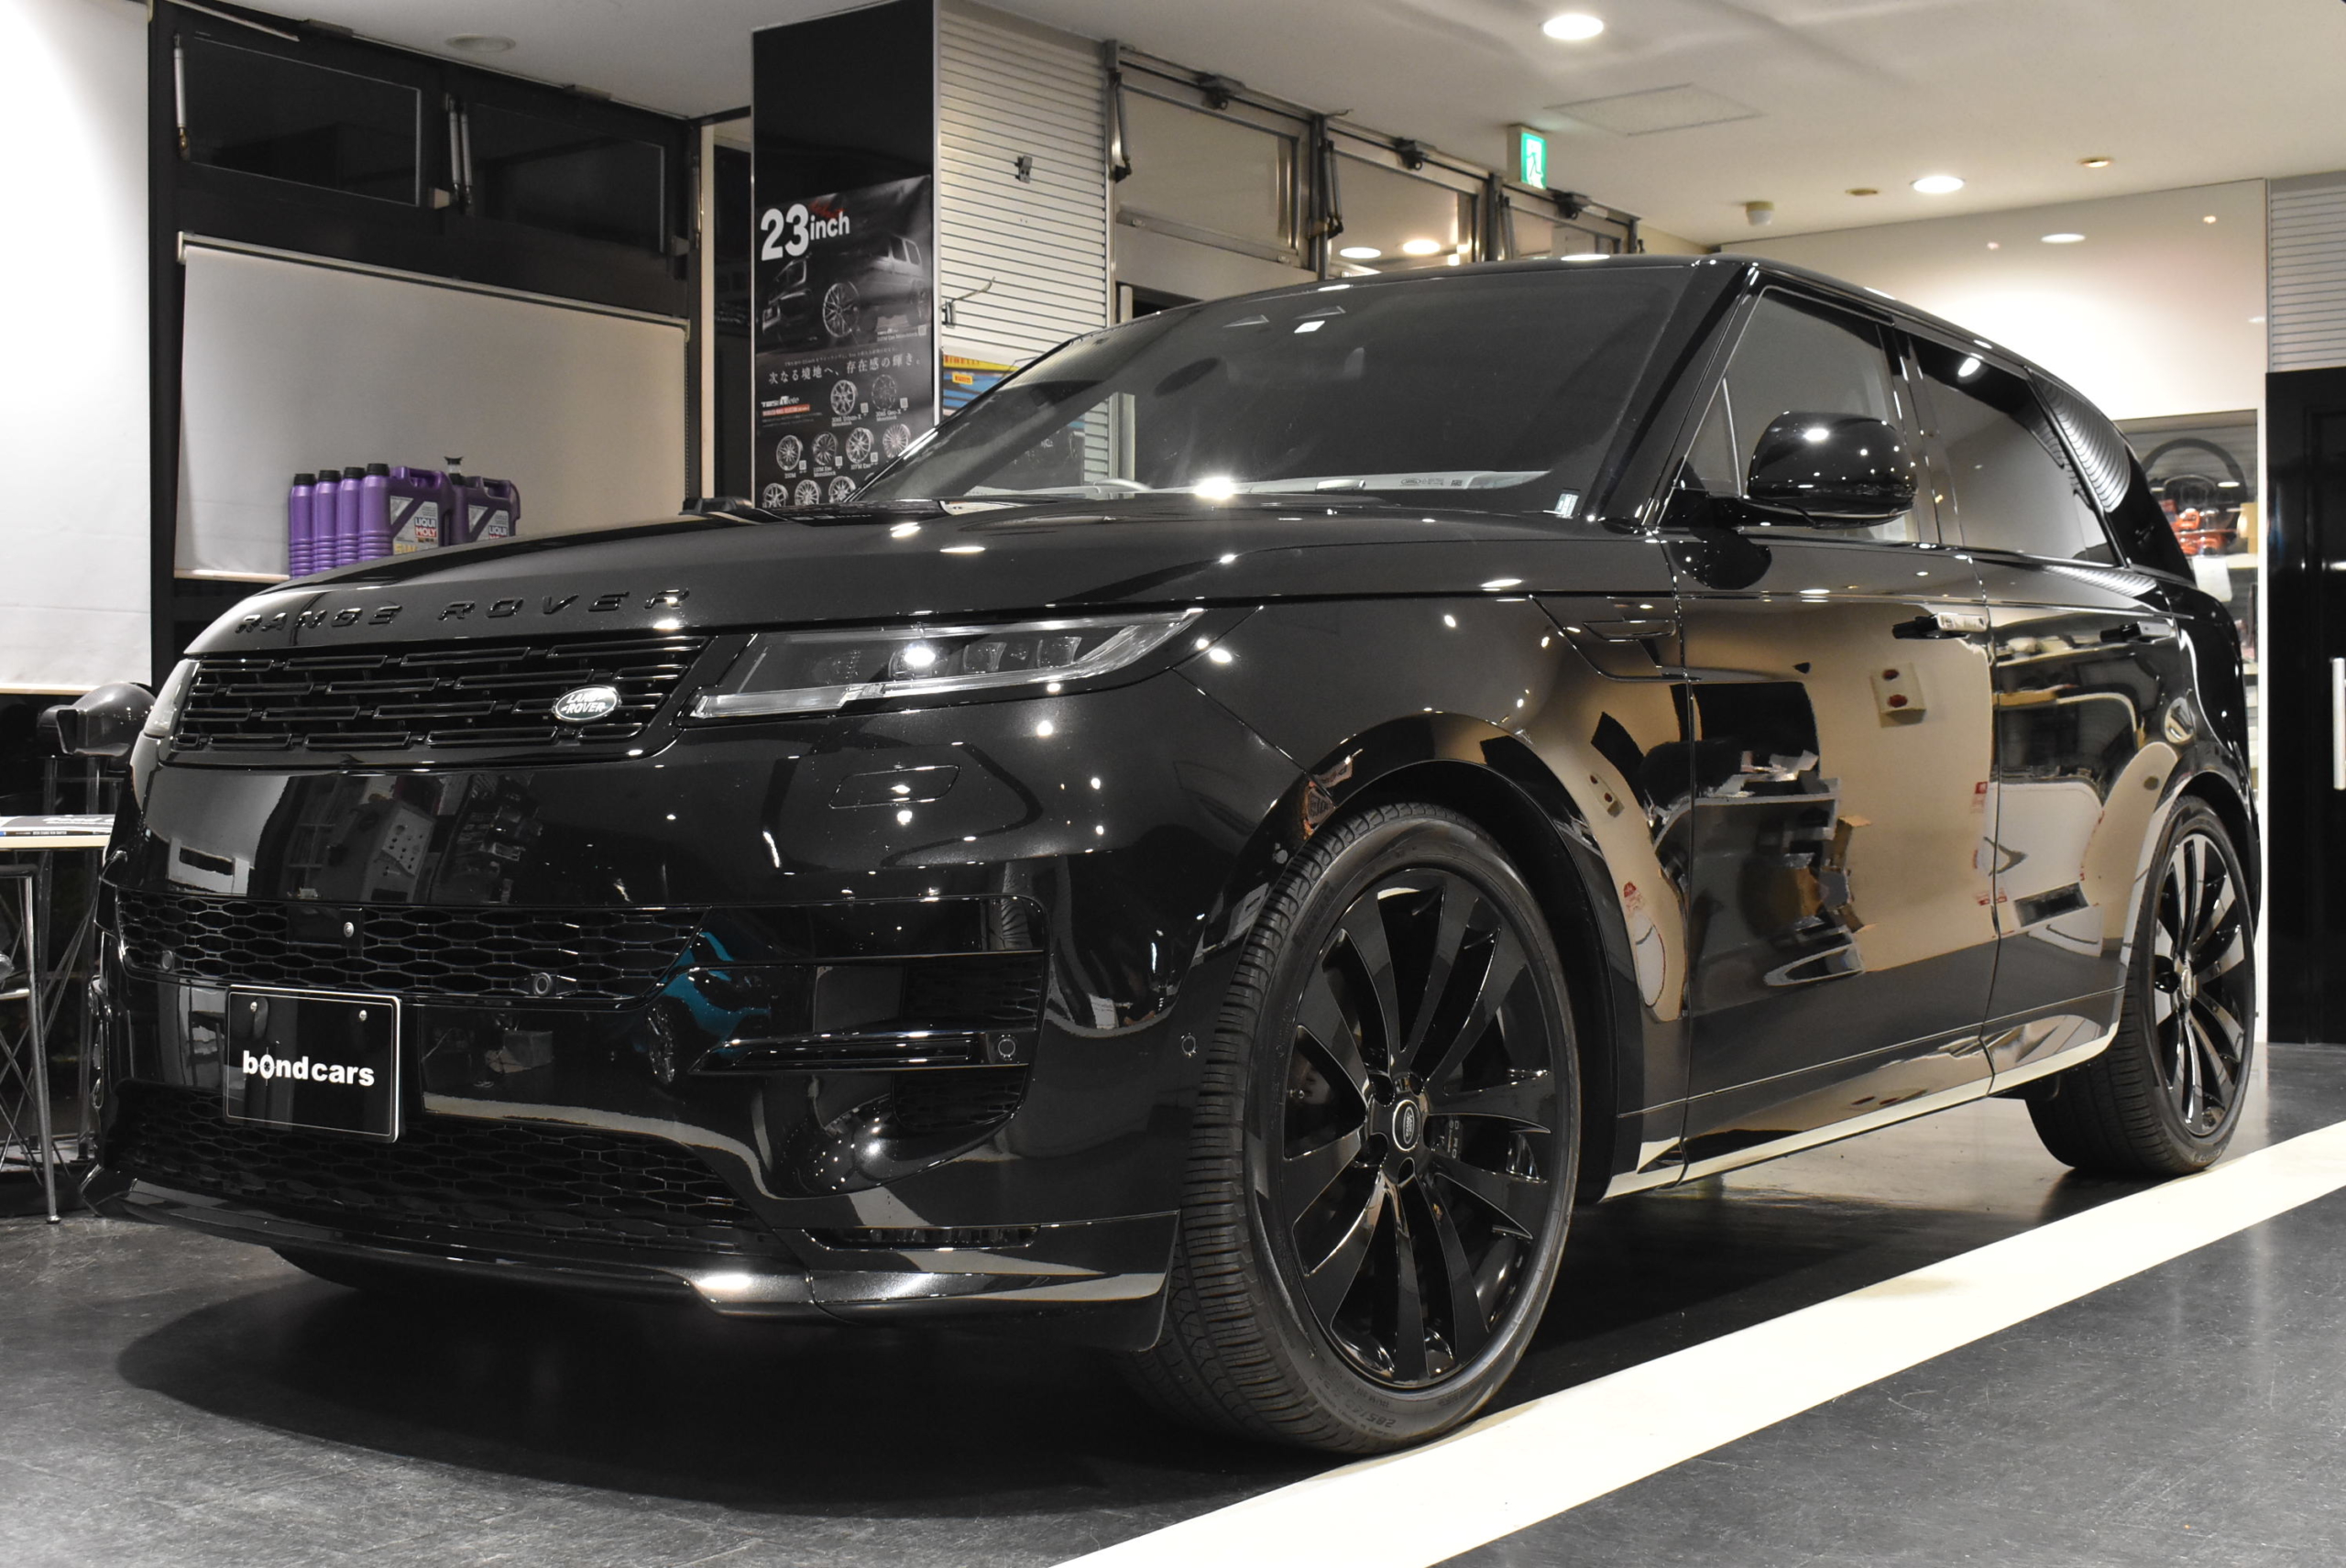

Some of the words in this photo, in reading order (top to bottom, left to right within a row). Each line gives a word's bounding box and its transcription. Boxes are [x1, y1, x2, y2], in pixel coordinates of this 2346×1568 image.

[415, 517, 436, 528] LIQUI
[415, 527, 437, 538] MOLY
[488, 525, 508, 537] LIQUI
[235, 605, 403, 632] RANGE
[437, 588, 690, 621] ROVER
[565, 702, 605, 714] ROVER
